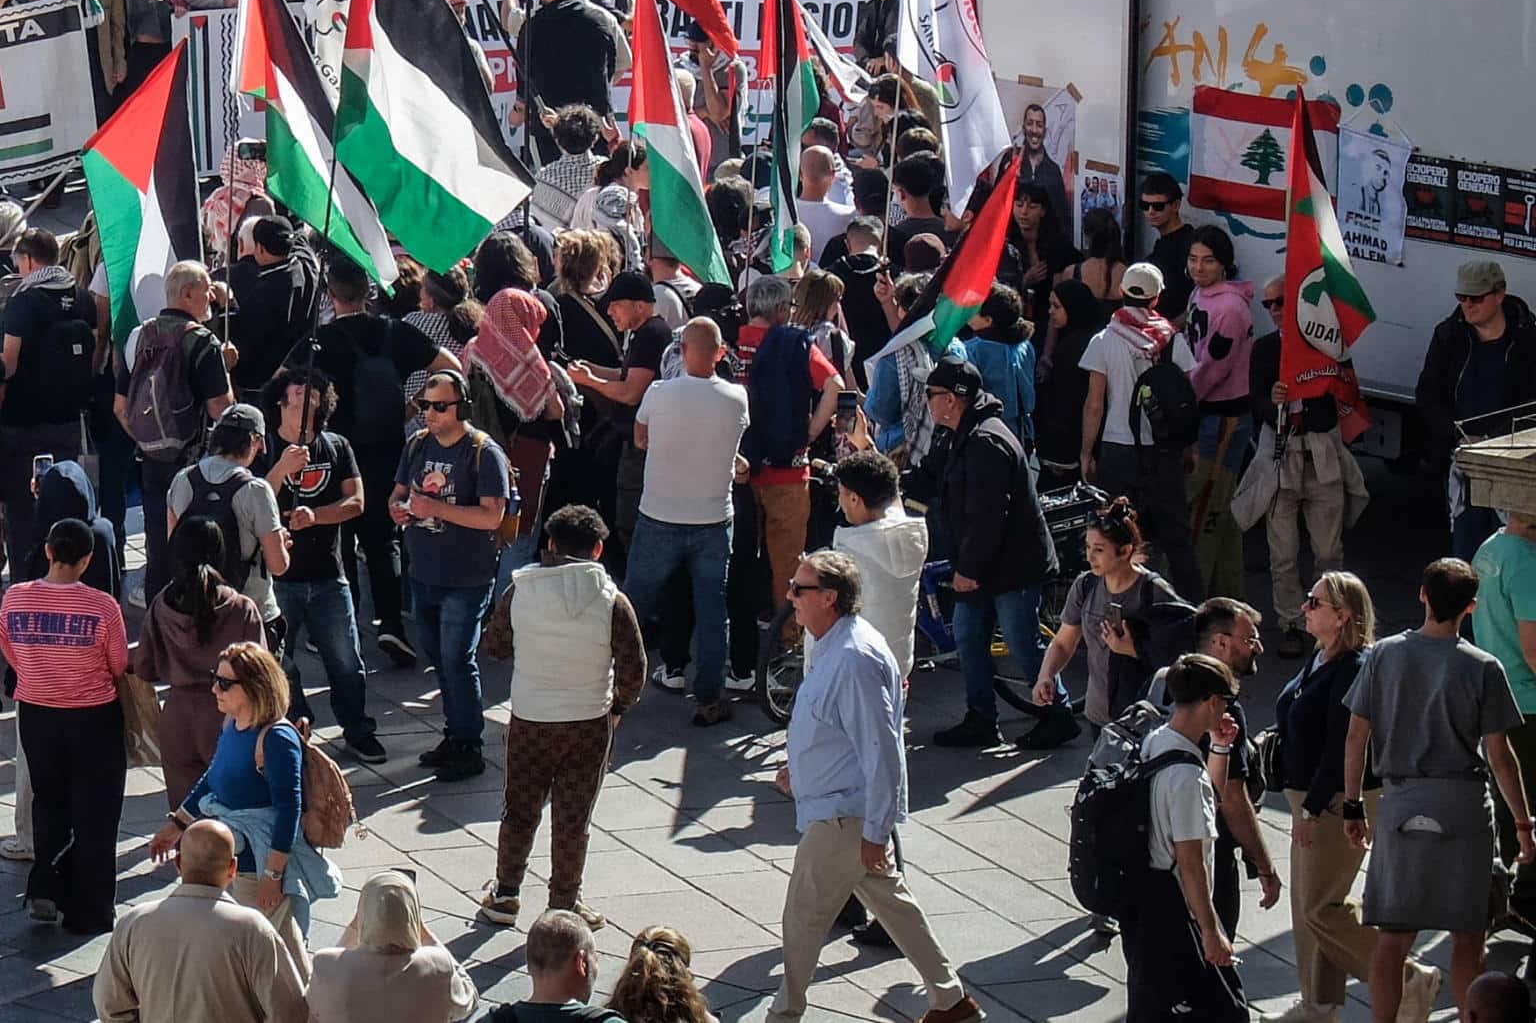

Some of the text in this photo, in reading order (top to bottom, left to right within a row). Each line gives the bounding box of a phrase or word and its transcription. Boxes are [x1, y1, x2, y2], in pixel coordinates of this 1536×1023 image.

[1406, 162, 1449, 178] SCIOPERO
[1457, 170, 1501, 186] SCIOPERO
[1406, 173, 1449, 188] GENERALE
[1457, 180, 1501, 196] GENERALE
[1343, 230, 1388, 251] AHMAD
